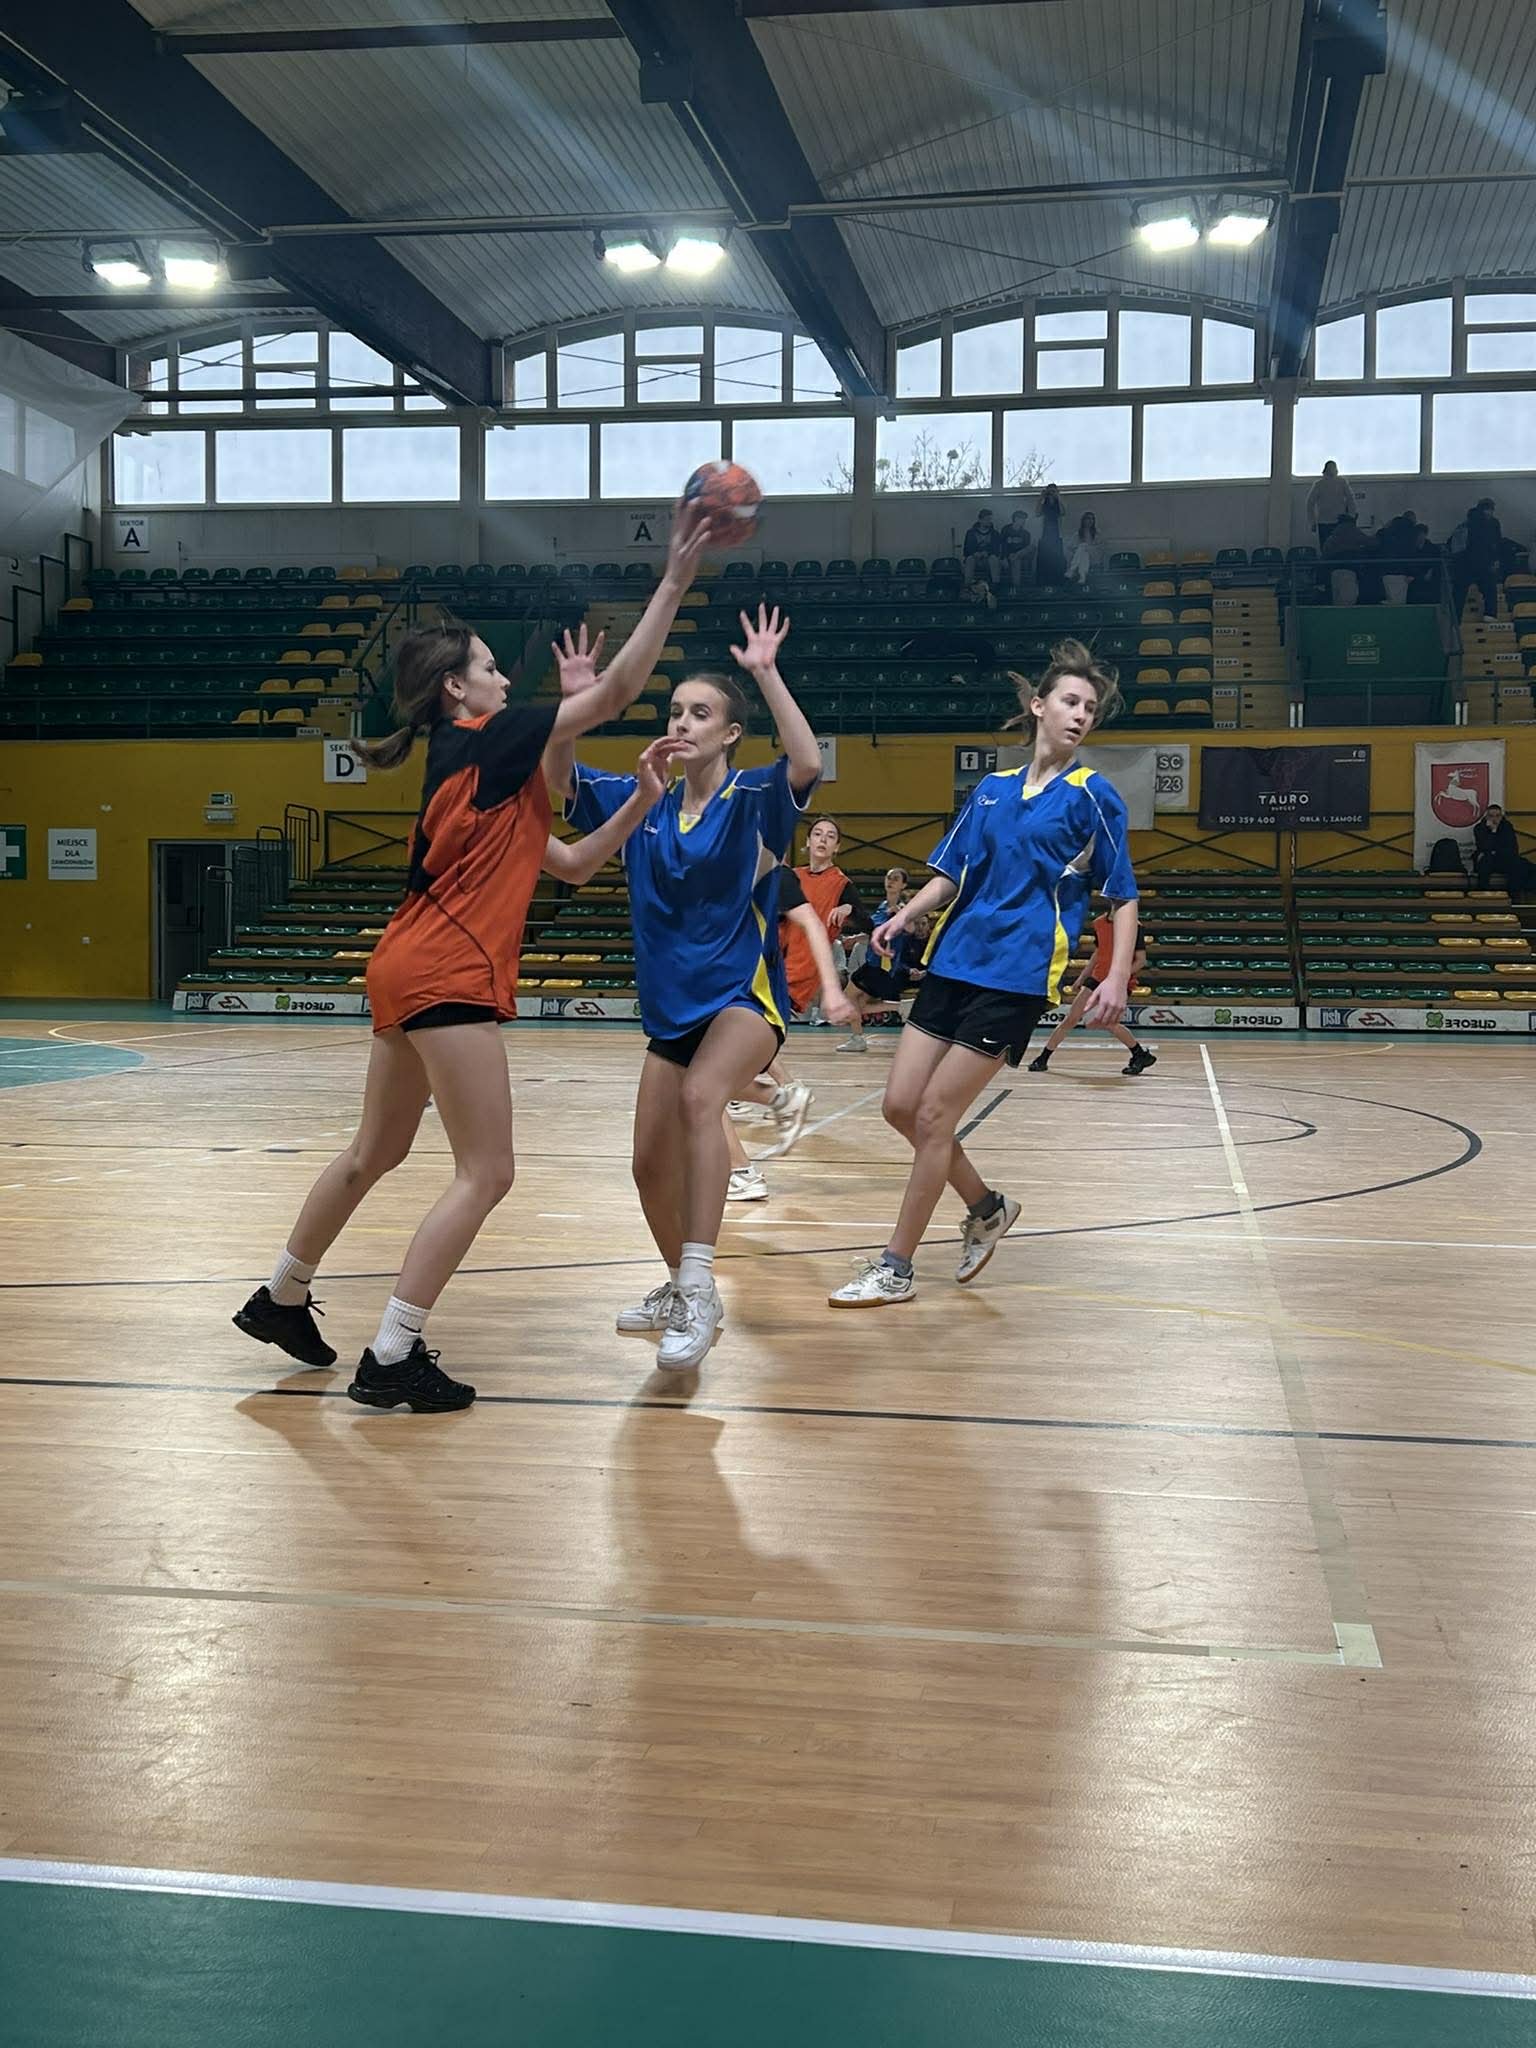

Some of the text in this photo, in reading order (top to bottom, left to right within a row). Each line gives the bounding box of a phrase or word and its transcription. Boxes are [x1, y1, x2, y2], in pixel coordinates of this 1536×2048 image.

[634, 521, 652, 541] A
[123, 527, 140, 547] A
[336, 753, 354, 777] D
[1259, 794, 1309, 805] TAURO
[1219, 816, 1275, 824] 503 359 400
[291, 1001, 335, 1011] BROBUD
[1233, 1016, 1283, 1025] BROBUD
[1322, 1009, 1341, 1027] psb
[1445, 1019, 1496, 1029] BROBUD
